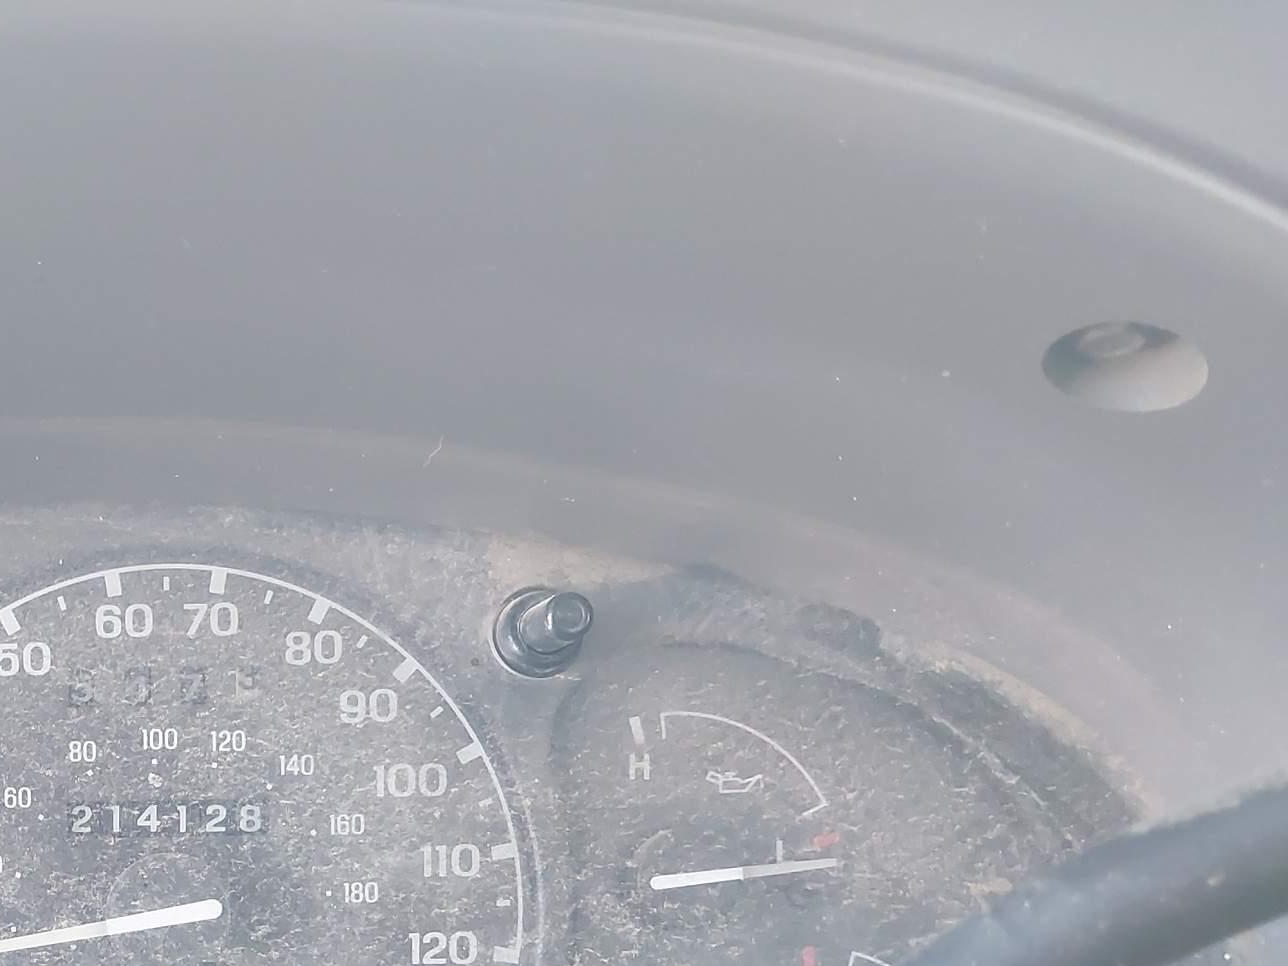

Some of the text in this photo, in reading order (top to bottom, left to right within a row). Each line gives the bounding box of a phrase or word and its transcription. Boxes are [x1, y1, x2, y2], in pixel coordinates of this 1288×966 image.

[95, 604, 153, 638] 60
[183, 602, 239, 638] 70
[285, 630, 343, 665] 80
[339, 688, 398, 724] 90
[69, 740, 97, 762] 80
[142, 728, 178, 750] 100
[210, 730, 246, 751] 120
[279, 754, 314, 776] 140
[629, 753, 650, 780] H
[373, 763, 448, 797] 100
[3, 787, 32, 808] 60
[71, 804, 262, 833] 214128
[330, 814, 365, 835] 160
[420, 844, 481, 877] 110
[343, 881, 379, 902] 180
[408, 931, 478, 965] 120
